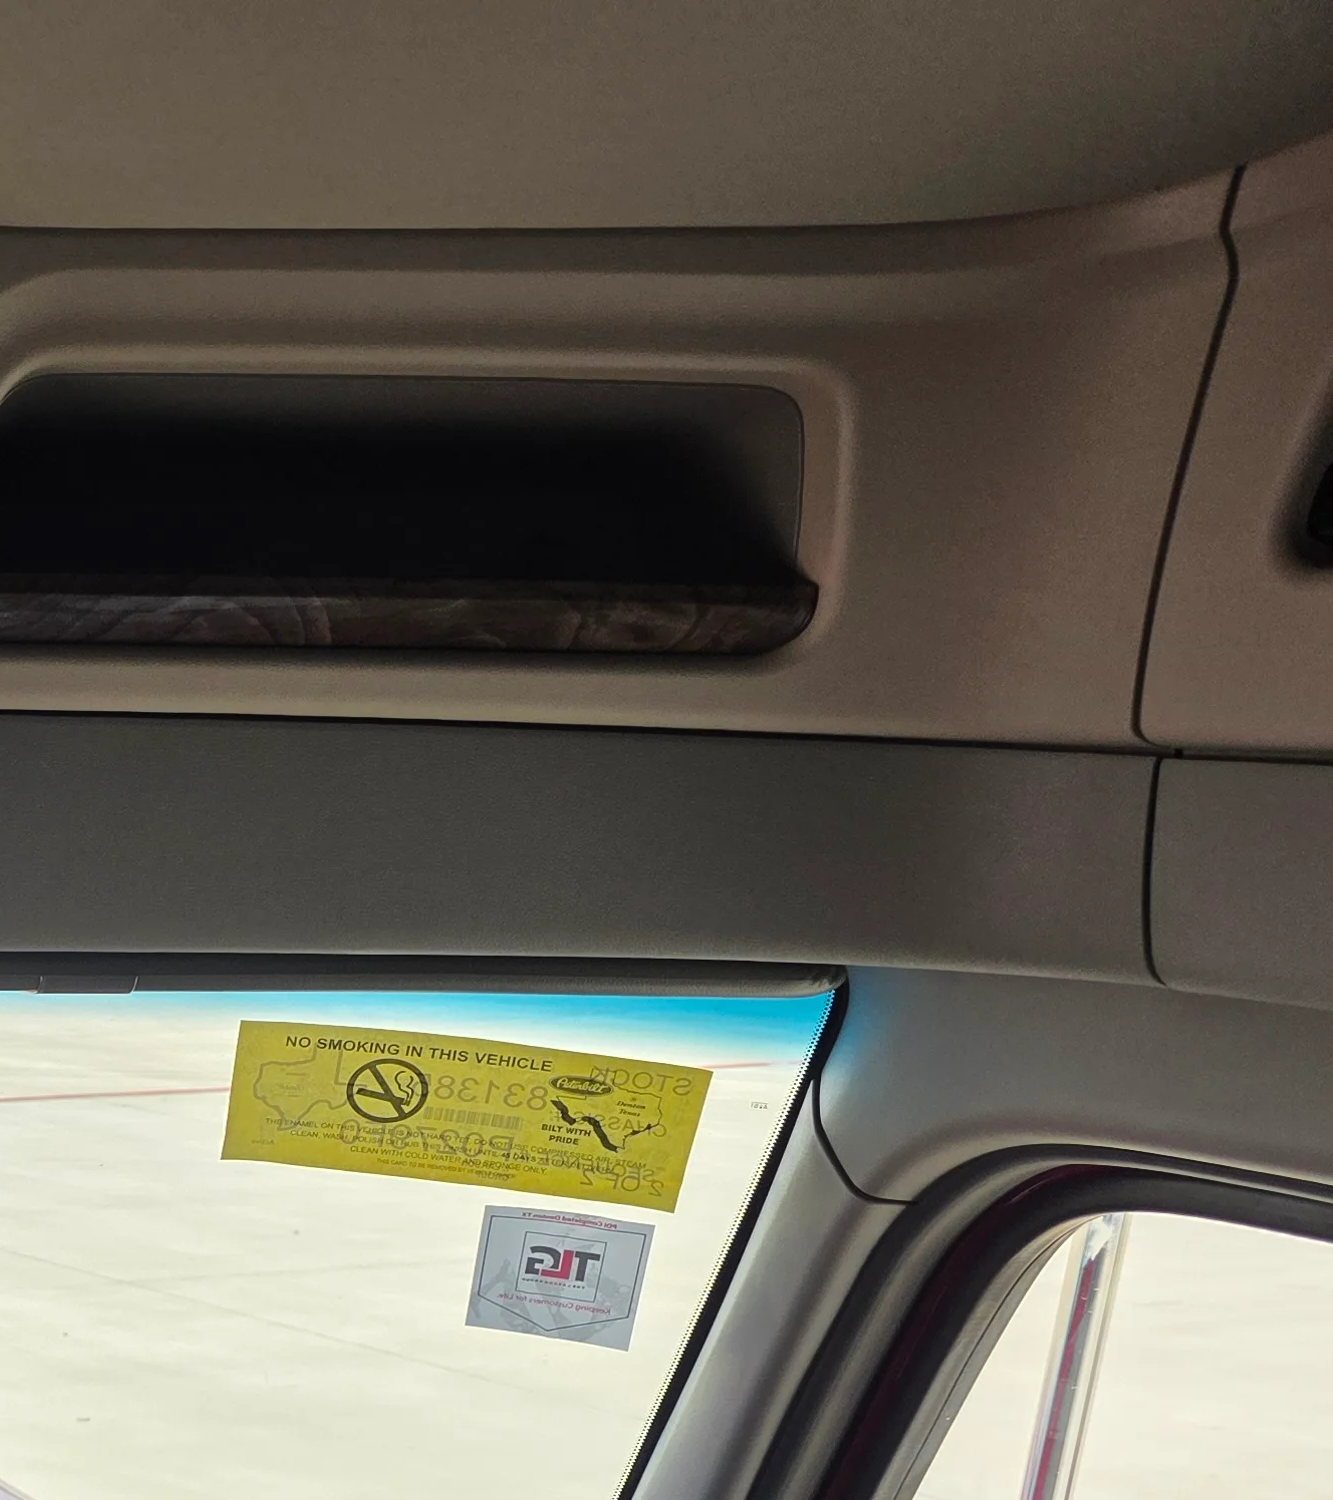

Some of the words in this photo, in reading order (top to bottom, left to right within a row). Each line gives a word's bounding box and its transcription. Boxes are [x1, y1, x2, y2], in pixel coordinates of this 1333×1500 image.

[285, 1035, 311, 1048] NO
[316, 1038, 400, 1056] SMOKING
[405, 1045, 422, 1058] IN
[428, 1047, 469, 1063] THIS
[475, 1052, 553, 1073] VEHICLE
[555, 1076, 609, 1095] Peterbilt
[616, 1100, 646, 1110] Denton
[265, 1117, 283, 1126] THE
[284, 1119, 317, 1129] ENAMEL
[320, 1122, 334, 1130] ON
[335, 1124, 355, 1133] THIS
[406, 1130, 425, 1139] NOT
[427, 1133, 451, 1142] HARD
[541, 1123, 562, 1134] BILT
[565, 1125, 592, 1137] WITH
[290, 1129, 321, 1139] CLEAN,
[513, 1152, 537, 1163] DAYS
[548, 1134, 579, 1146] PRIDE
[350, 1145, 379, 1155] CLEAN
[381, 1147, 403, 1157] WITH
[405, 1150, 430, 1160] COLD
[431, 1153, 462, 1164] WATER
